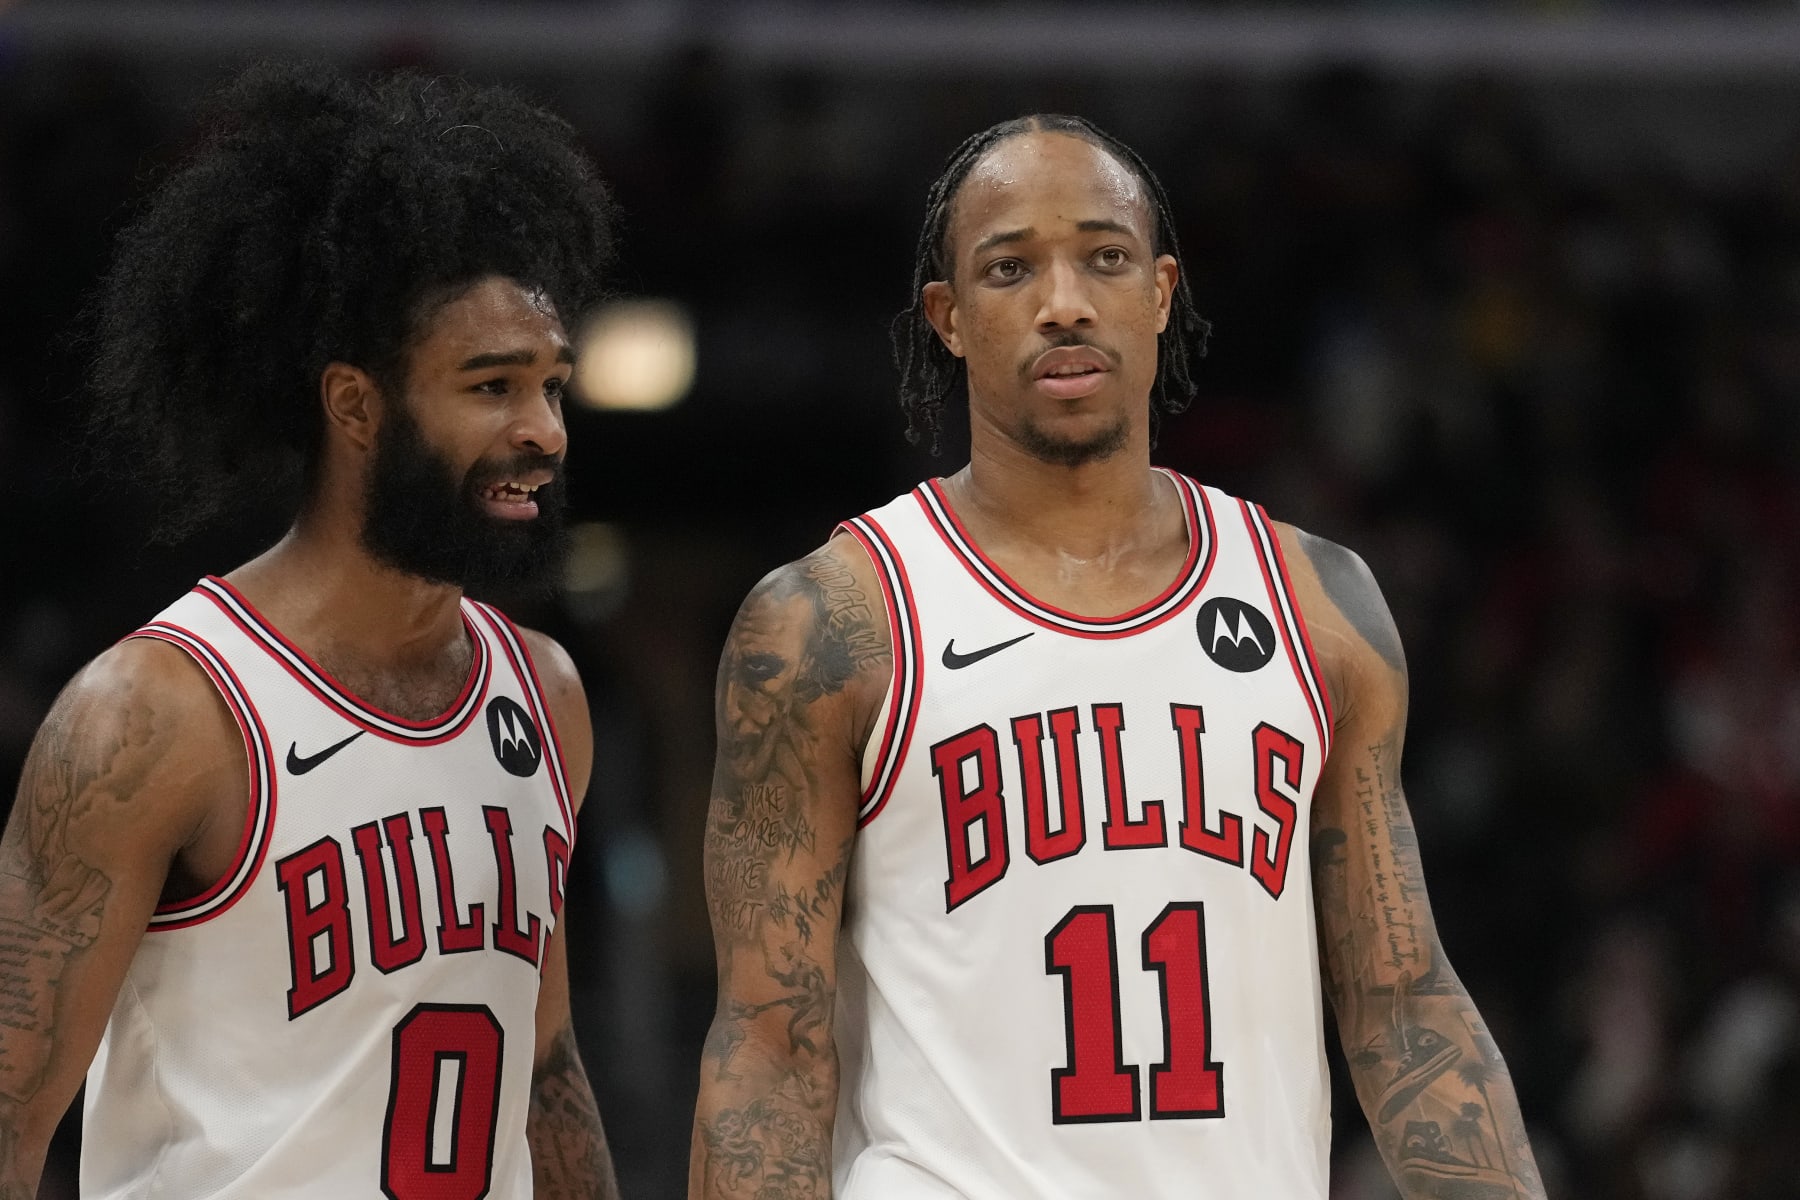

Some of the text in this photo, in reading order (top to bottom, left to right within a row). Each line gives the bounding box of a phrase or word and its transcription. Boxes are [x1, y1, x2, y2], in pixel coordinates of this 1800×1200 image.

[743, 784, 786, 814] MAKE
[930, 702, 1304, 914] BULLS
[380, 1002, 504, 1200] 0
[1045, 901, 1225, 1125] 11
